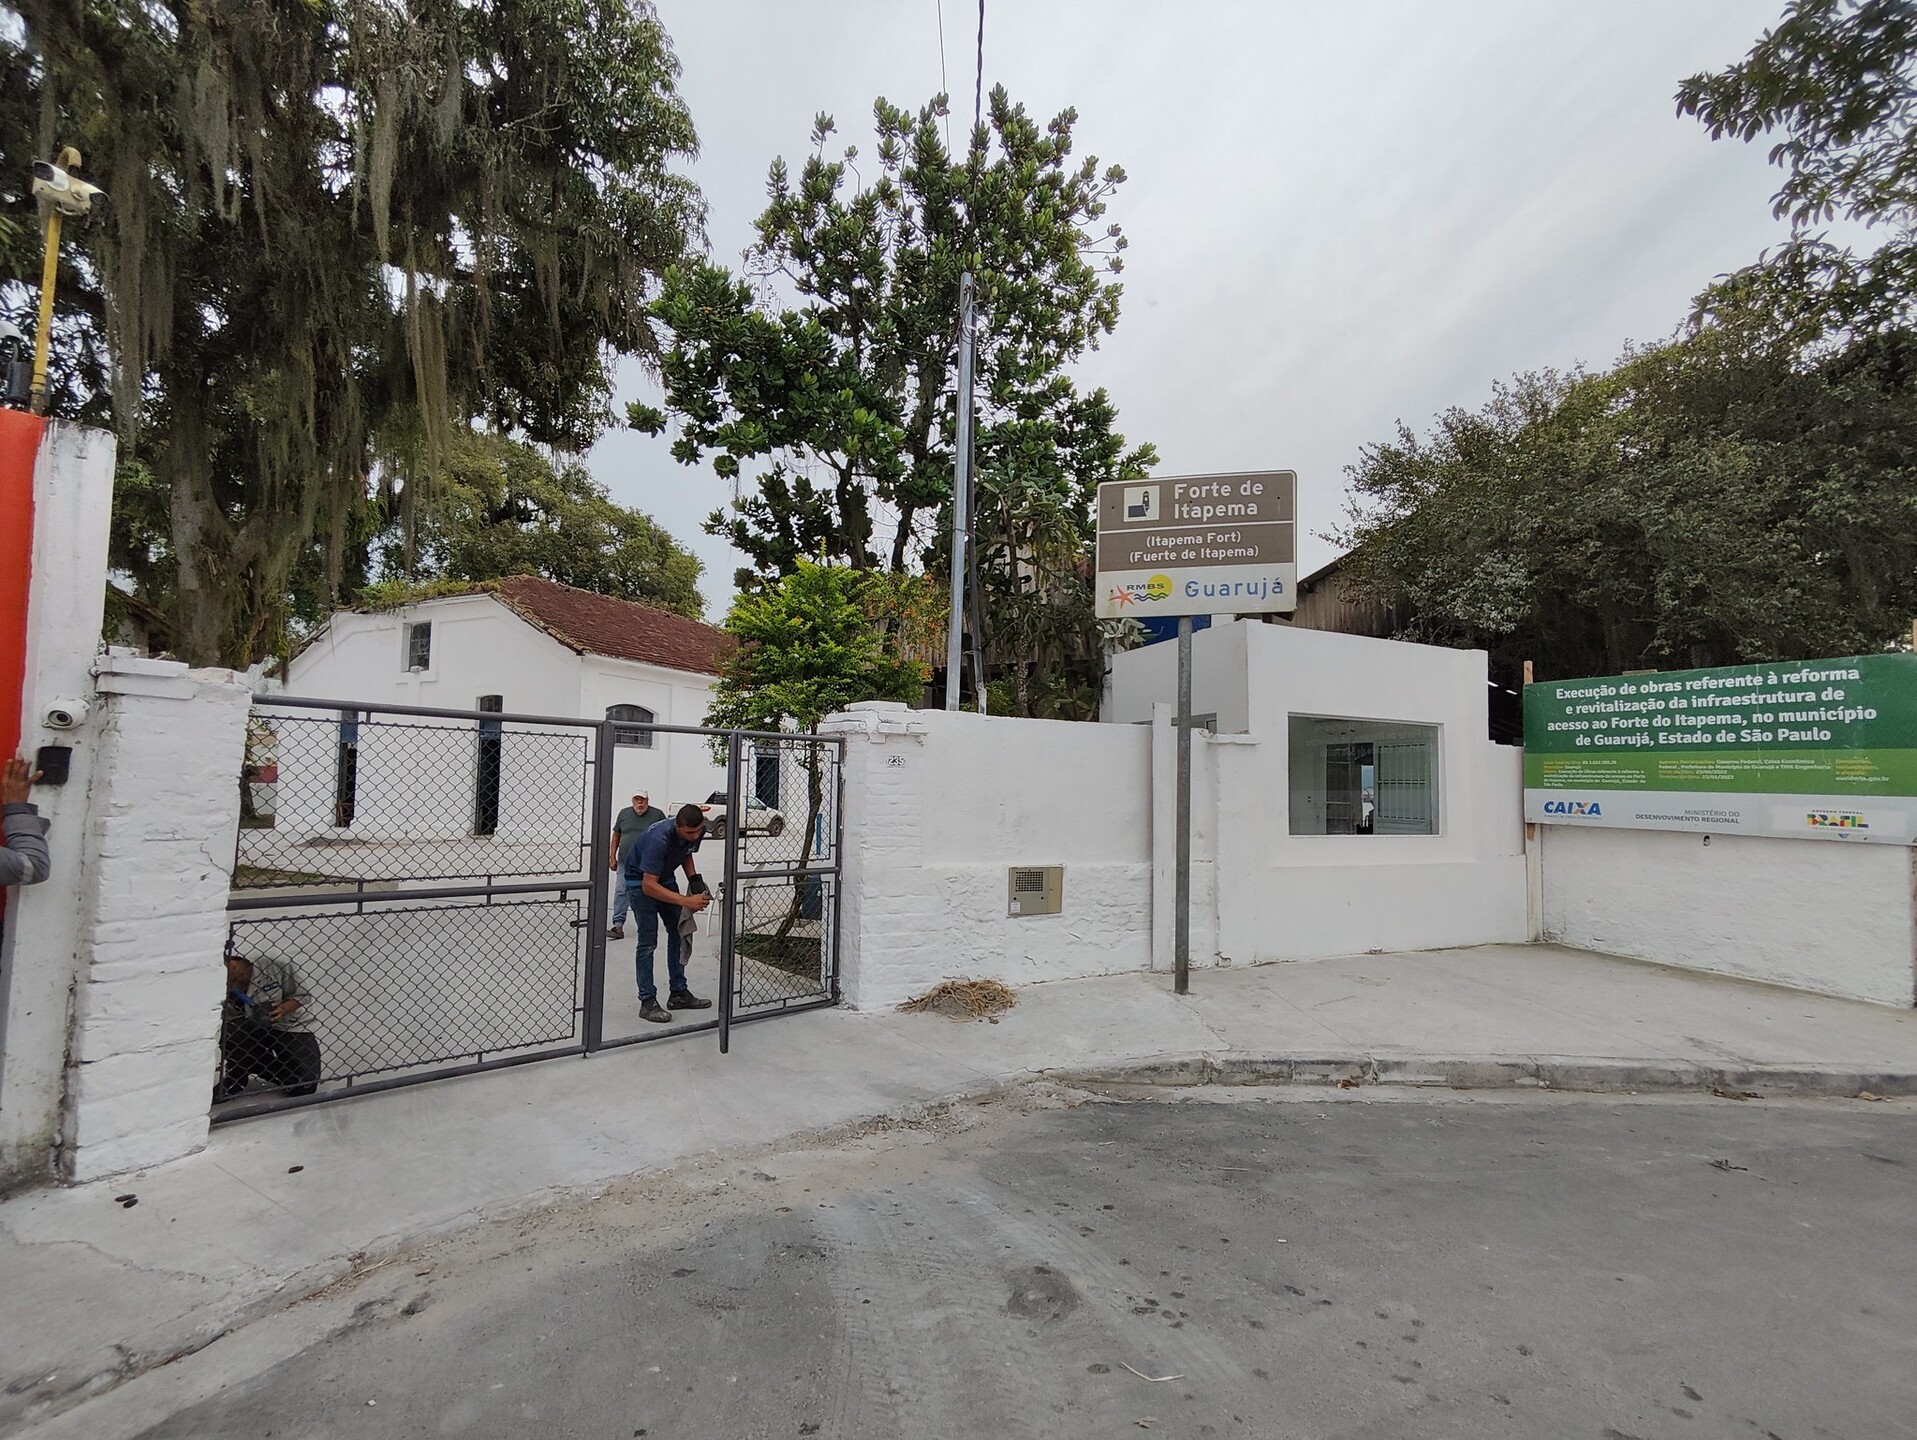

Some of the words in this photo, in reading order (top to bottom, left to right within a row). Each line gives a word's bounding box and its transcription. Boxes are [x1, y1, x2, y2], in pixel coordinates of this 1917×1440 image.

[1174, 481, 1231, 499] Forte
[1240, 480, 1263, 496] de
[1174, 502, 1258, 522] Itapema
[1146, 534, 1203, 548] (Itapema
[1207, 531, 1241, 543] Fort)
[1130, 550, 1177, 563] (Fuerte
[1181, 548, 1196, 560] de
[1201, 545, 1259, 560] Itapema)
[1126, 583, 1165, 591] RMBS
[1185, 577, 1283, 600] Guarujá
[1556, 685, 1617, 699] Execução
[1620, 683, 1637, 695] de
[1640, 681, 1682, 693] obras
[1685, 676, 1763, 691] referente
[1767, 671, 1778, 685] à
[1782, 668, 1860, 684] reforma
[1565, 705, 1573, 715] e
[1575, 698, 1665, 713] revitalização
[1669, 697, 1688, 709] da
[1692, 691, 1816, 708] infraestrutura
[1821, 687, 1845, 701] de
[1547, 721, 1589, 731] acesso
[1592, 720, 1608, 729] ao
[1611, 717, 1649, 729] Forte
[1652, 715, 1671, 727] do
[1675, 713, 1748, 728] Itapema,
[1752, 713, 1774, 723] no
[1779, 706, 1877, 724] município
[1575, 734, 1591, 746] de
[1594, 732, 1654, 747] Guarujá,
[1658, 730, 1712, 744] Estado
[1715, 730, 1737, 743] de
[1740, 729, 1773, 742] São
[1777, 727, 1831, 741] Paulo
[888, 756, 904, 765] 235
[1544, 800, 1602, 816] CAIXA
[1685, 809, 1727, 817] MINISTÉRIO
[1635, 814, 1700, 822] DESENVOVIMENTO
[1701, 816, 1740, 824] REGIONAL
[1807, 813, 1869, 829] BRASIL
